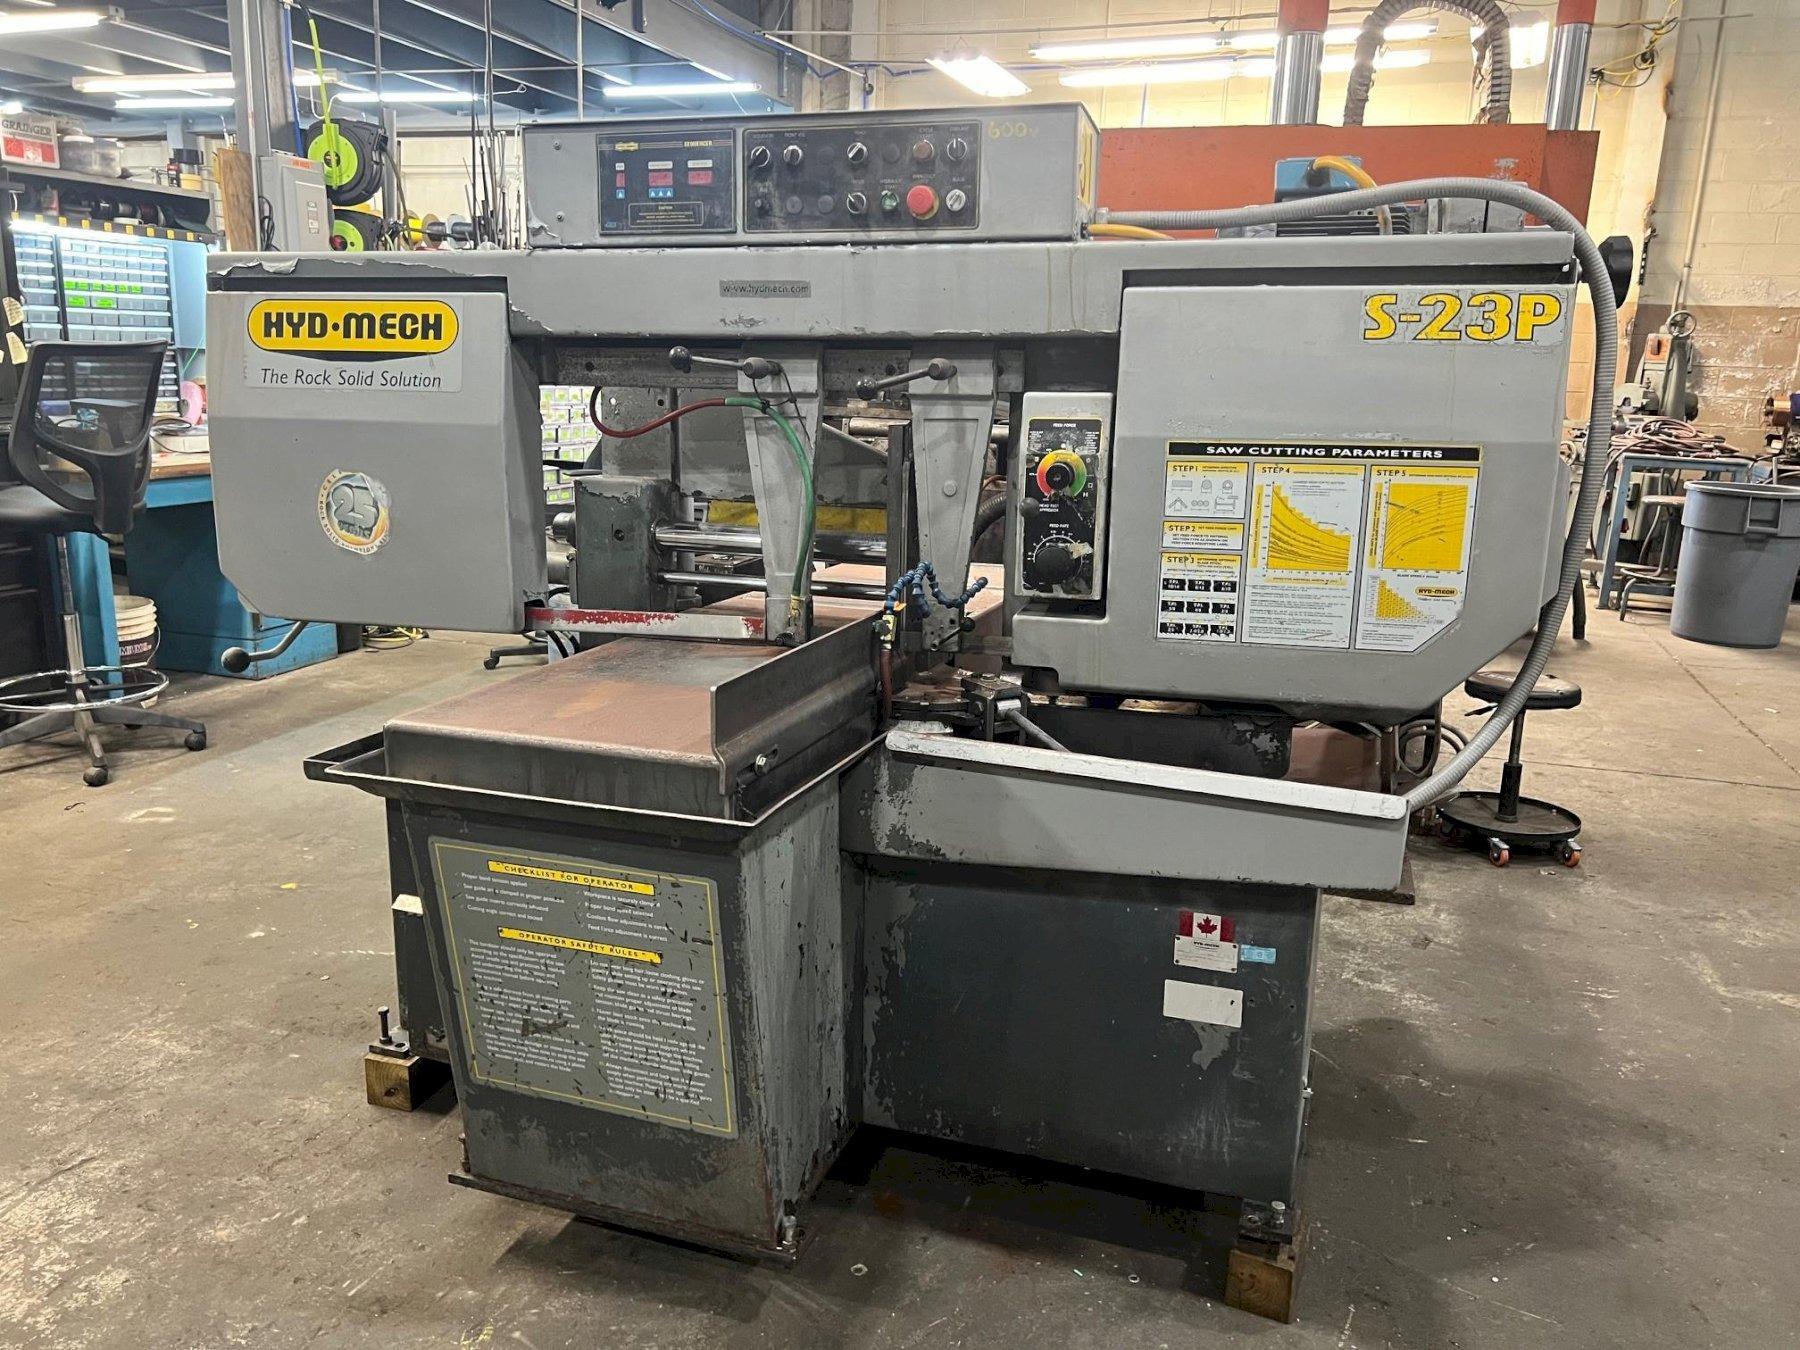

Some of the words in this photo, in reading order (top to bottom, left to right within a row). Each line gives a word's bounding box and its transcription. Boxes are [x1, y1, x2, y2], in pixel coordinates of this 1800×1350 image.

[1363, 292, 1562, 342] S-23P
[261, 368, 288, 384] The
[294, 368, 332, 386] Rock
[338, 370, 374, 386] Solid
[380, 370, 442, 388] Solution
[1206, 446, 1244, 454] SAW
[1248, 447, 1326, 456] CUTTING
[1332, 448, 1443, 458] PARAMETERS
[504, 866, 555, 878] CHECKLIST
[561, 874, 579, 882] FOR
[584, 878, 633, 890] OPERATOR
[519, 932, 566, 945] OPERATOR
[610, 947, 638, 956] RULES
